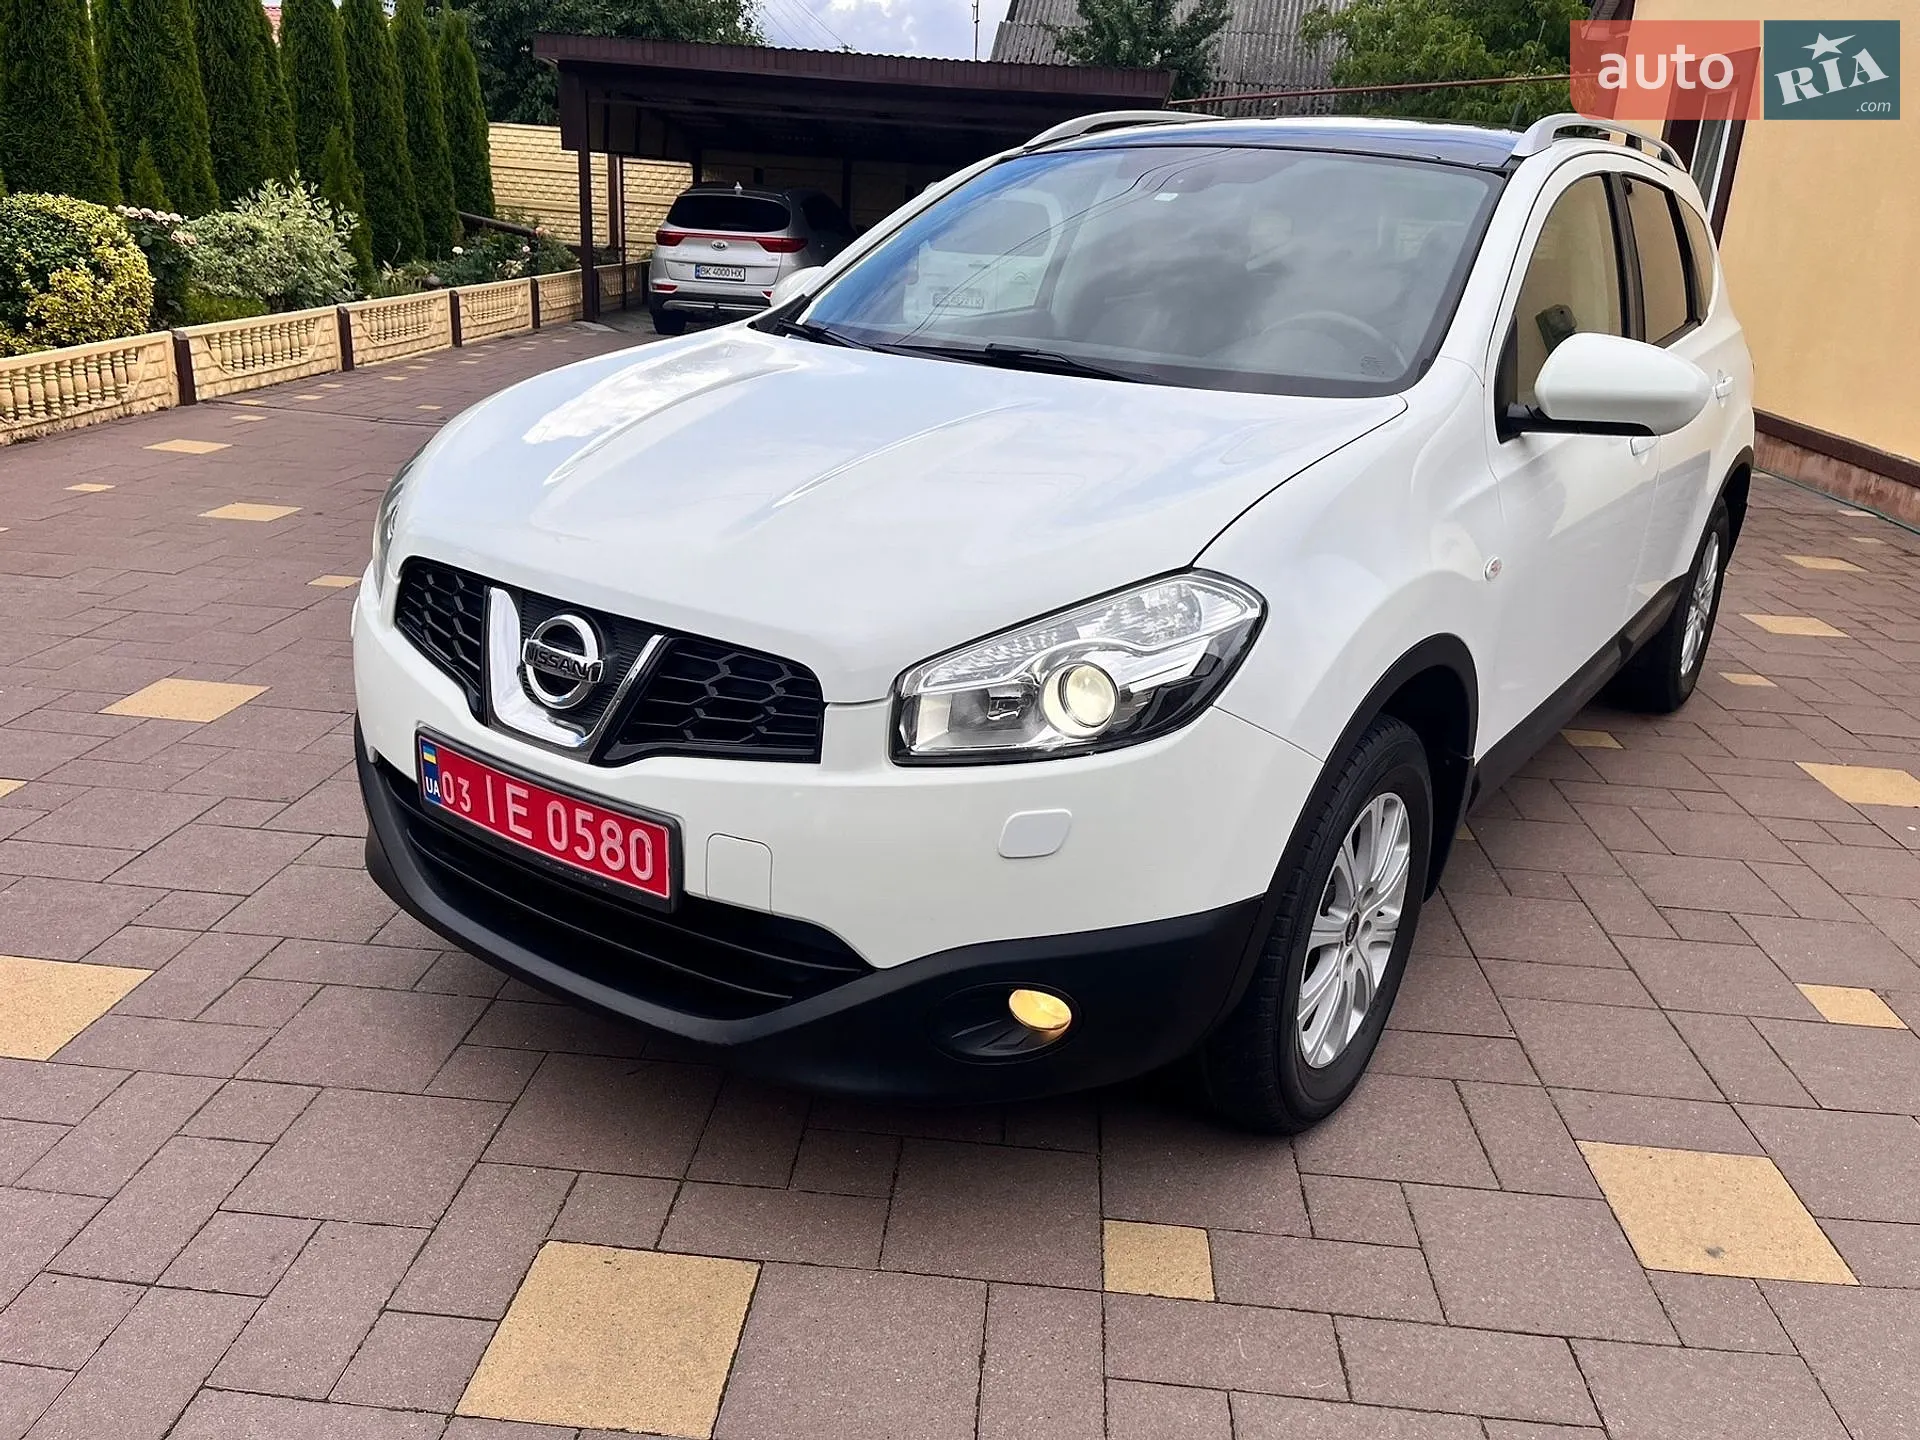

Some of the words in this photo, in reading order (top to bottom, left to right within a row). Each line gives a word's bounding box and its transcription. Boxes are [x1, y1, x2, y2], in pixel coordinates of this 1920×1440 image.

[700, 266, 712, 276] BK
[712, 267, 730, 277] 4000
[526, 642, 588, 678] NISSAN
[425, 776, 441, 797] UA
[442, 771, 472, 813] 03
[485, 774, 532, 840] IE
[546, 800, 653, 881] 0580
